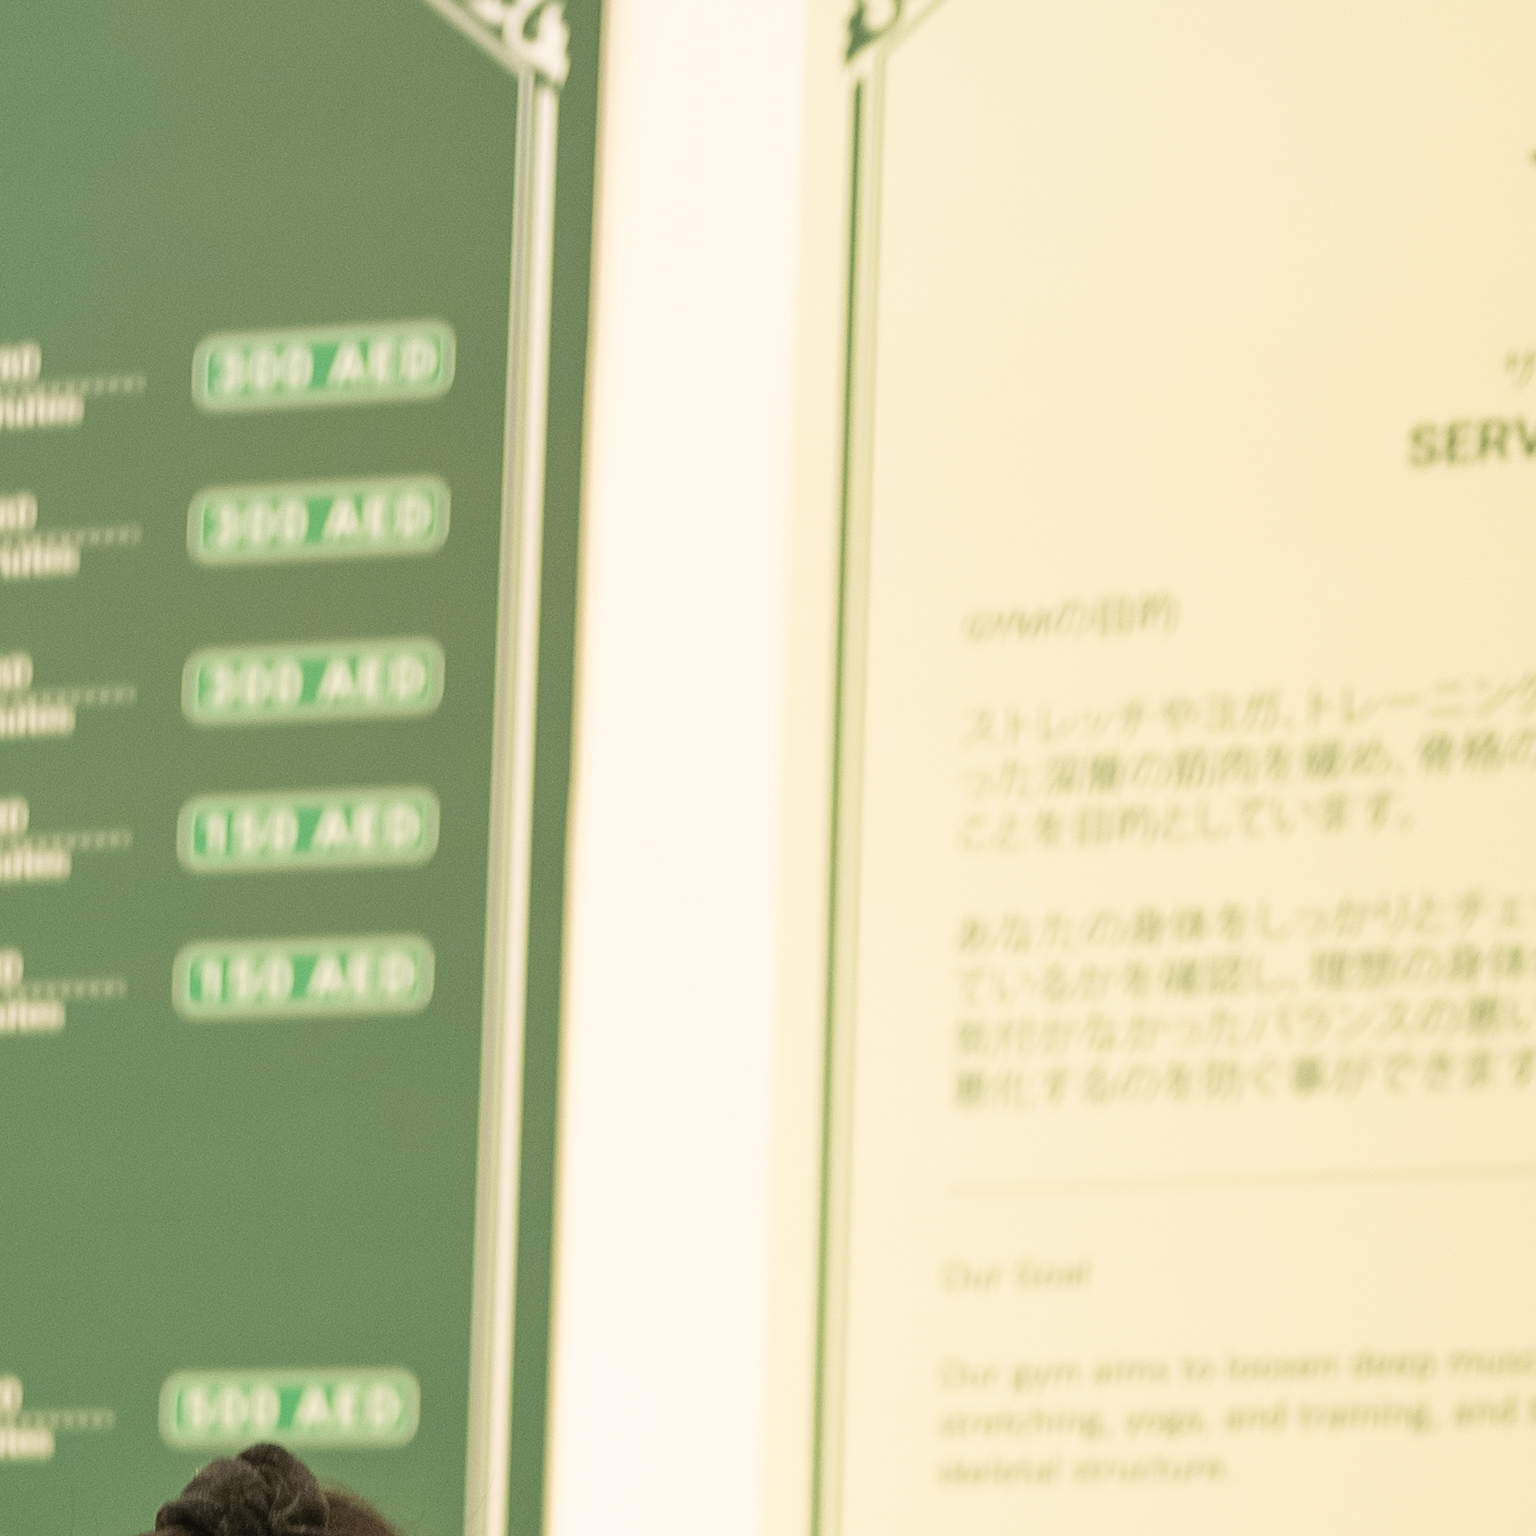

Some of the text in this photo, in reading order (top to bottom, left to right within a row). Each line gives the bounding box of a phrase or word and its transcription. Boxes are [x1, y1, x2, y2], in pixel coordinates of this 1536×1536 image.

[330, 339, 439, 387] AED
[323, 494, 434, 541] AED
[319, 654, 426, 701] AED
[314, 804, 421, 851] AED
[308, 952, 415, 998] AED
[295, 1384, 403, 1431] AED
